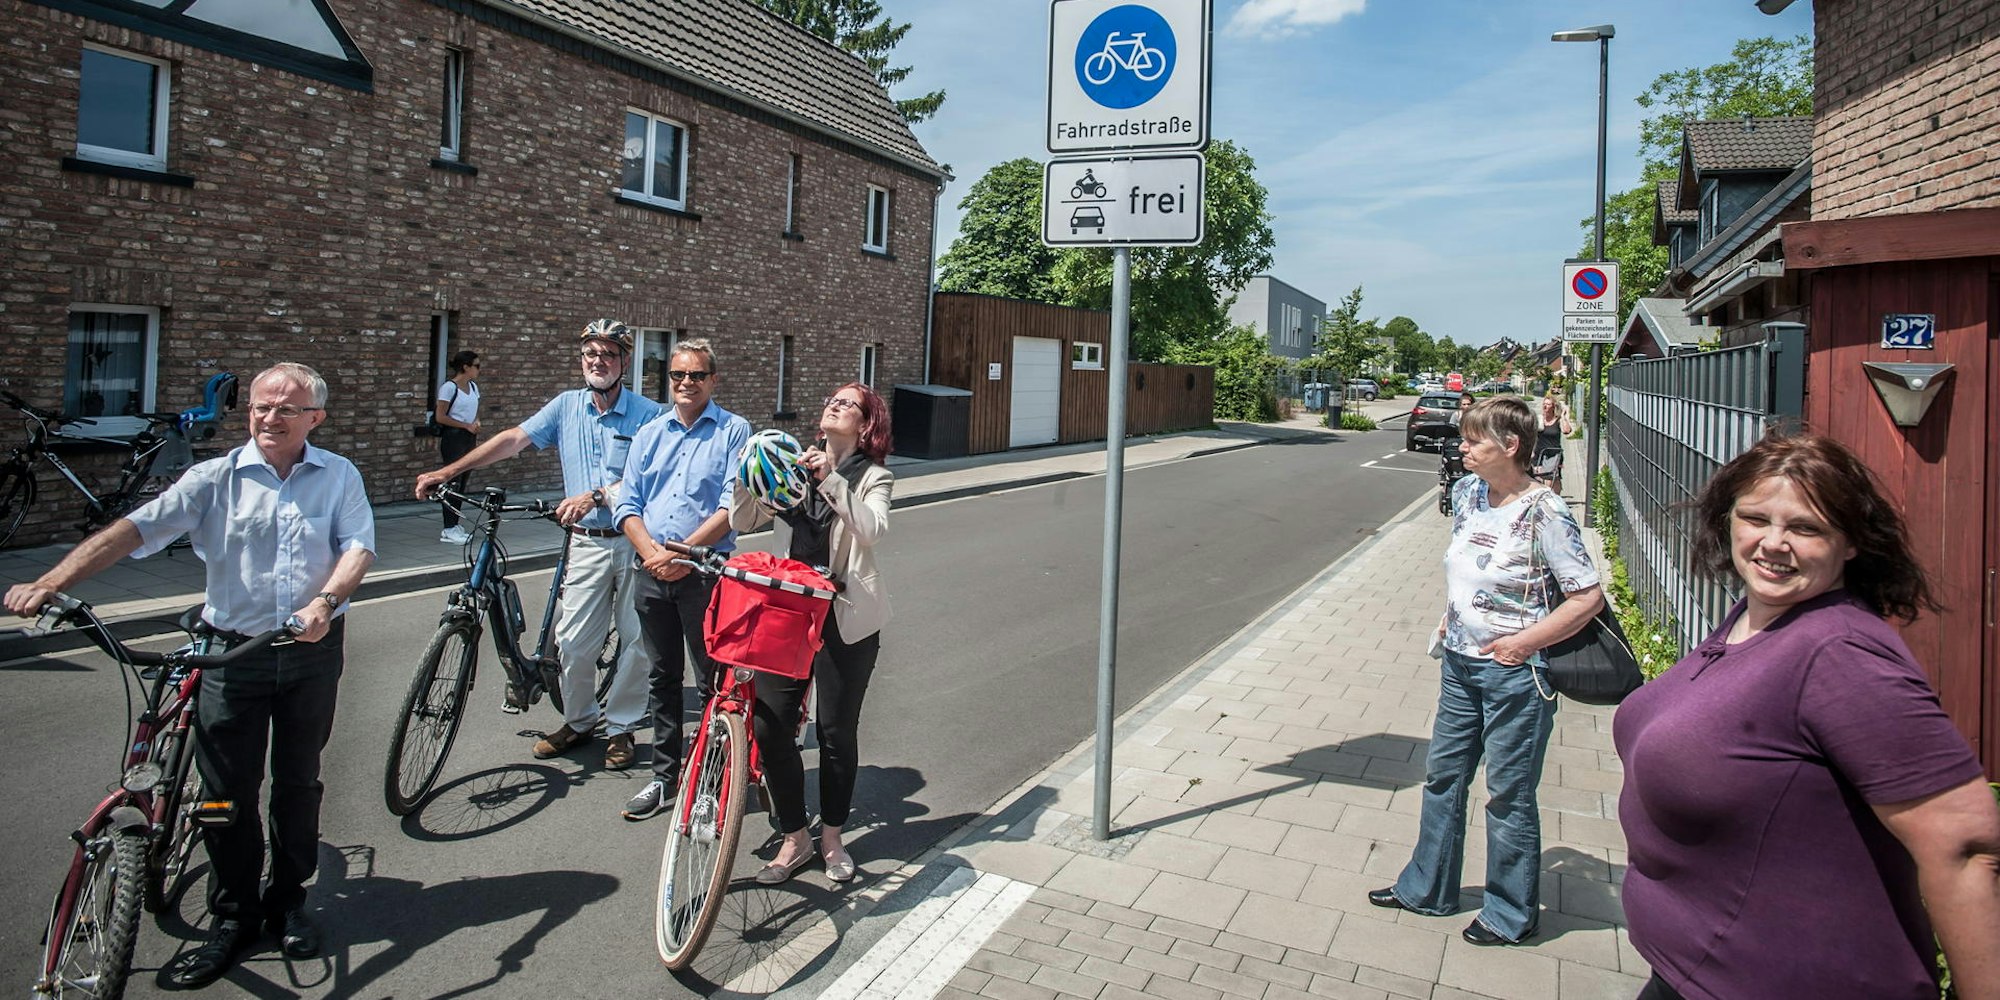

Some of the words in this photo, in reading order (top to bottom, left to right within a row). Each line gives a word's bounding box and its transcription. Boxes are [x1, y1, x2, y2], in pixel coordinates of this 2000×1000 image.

[1057, 116, 1192, 139] Fahrradstraße
[1129, 184, 1185, 214] frei
[1576, 301, 1603, 310] ZONE
[1889, 318, 1928, 345] 27
